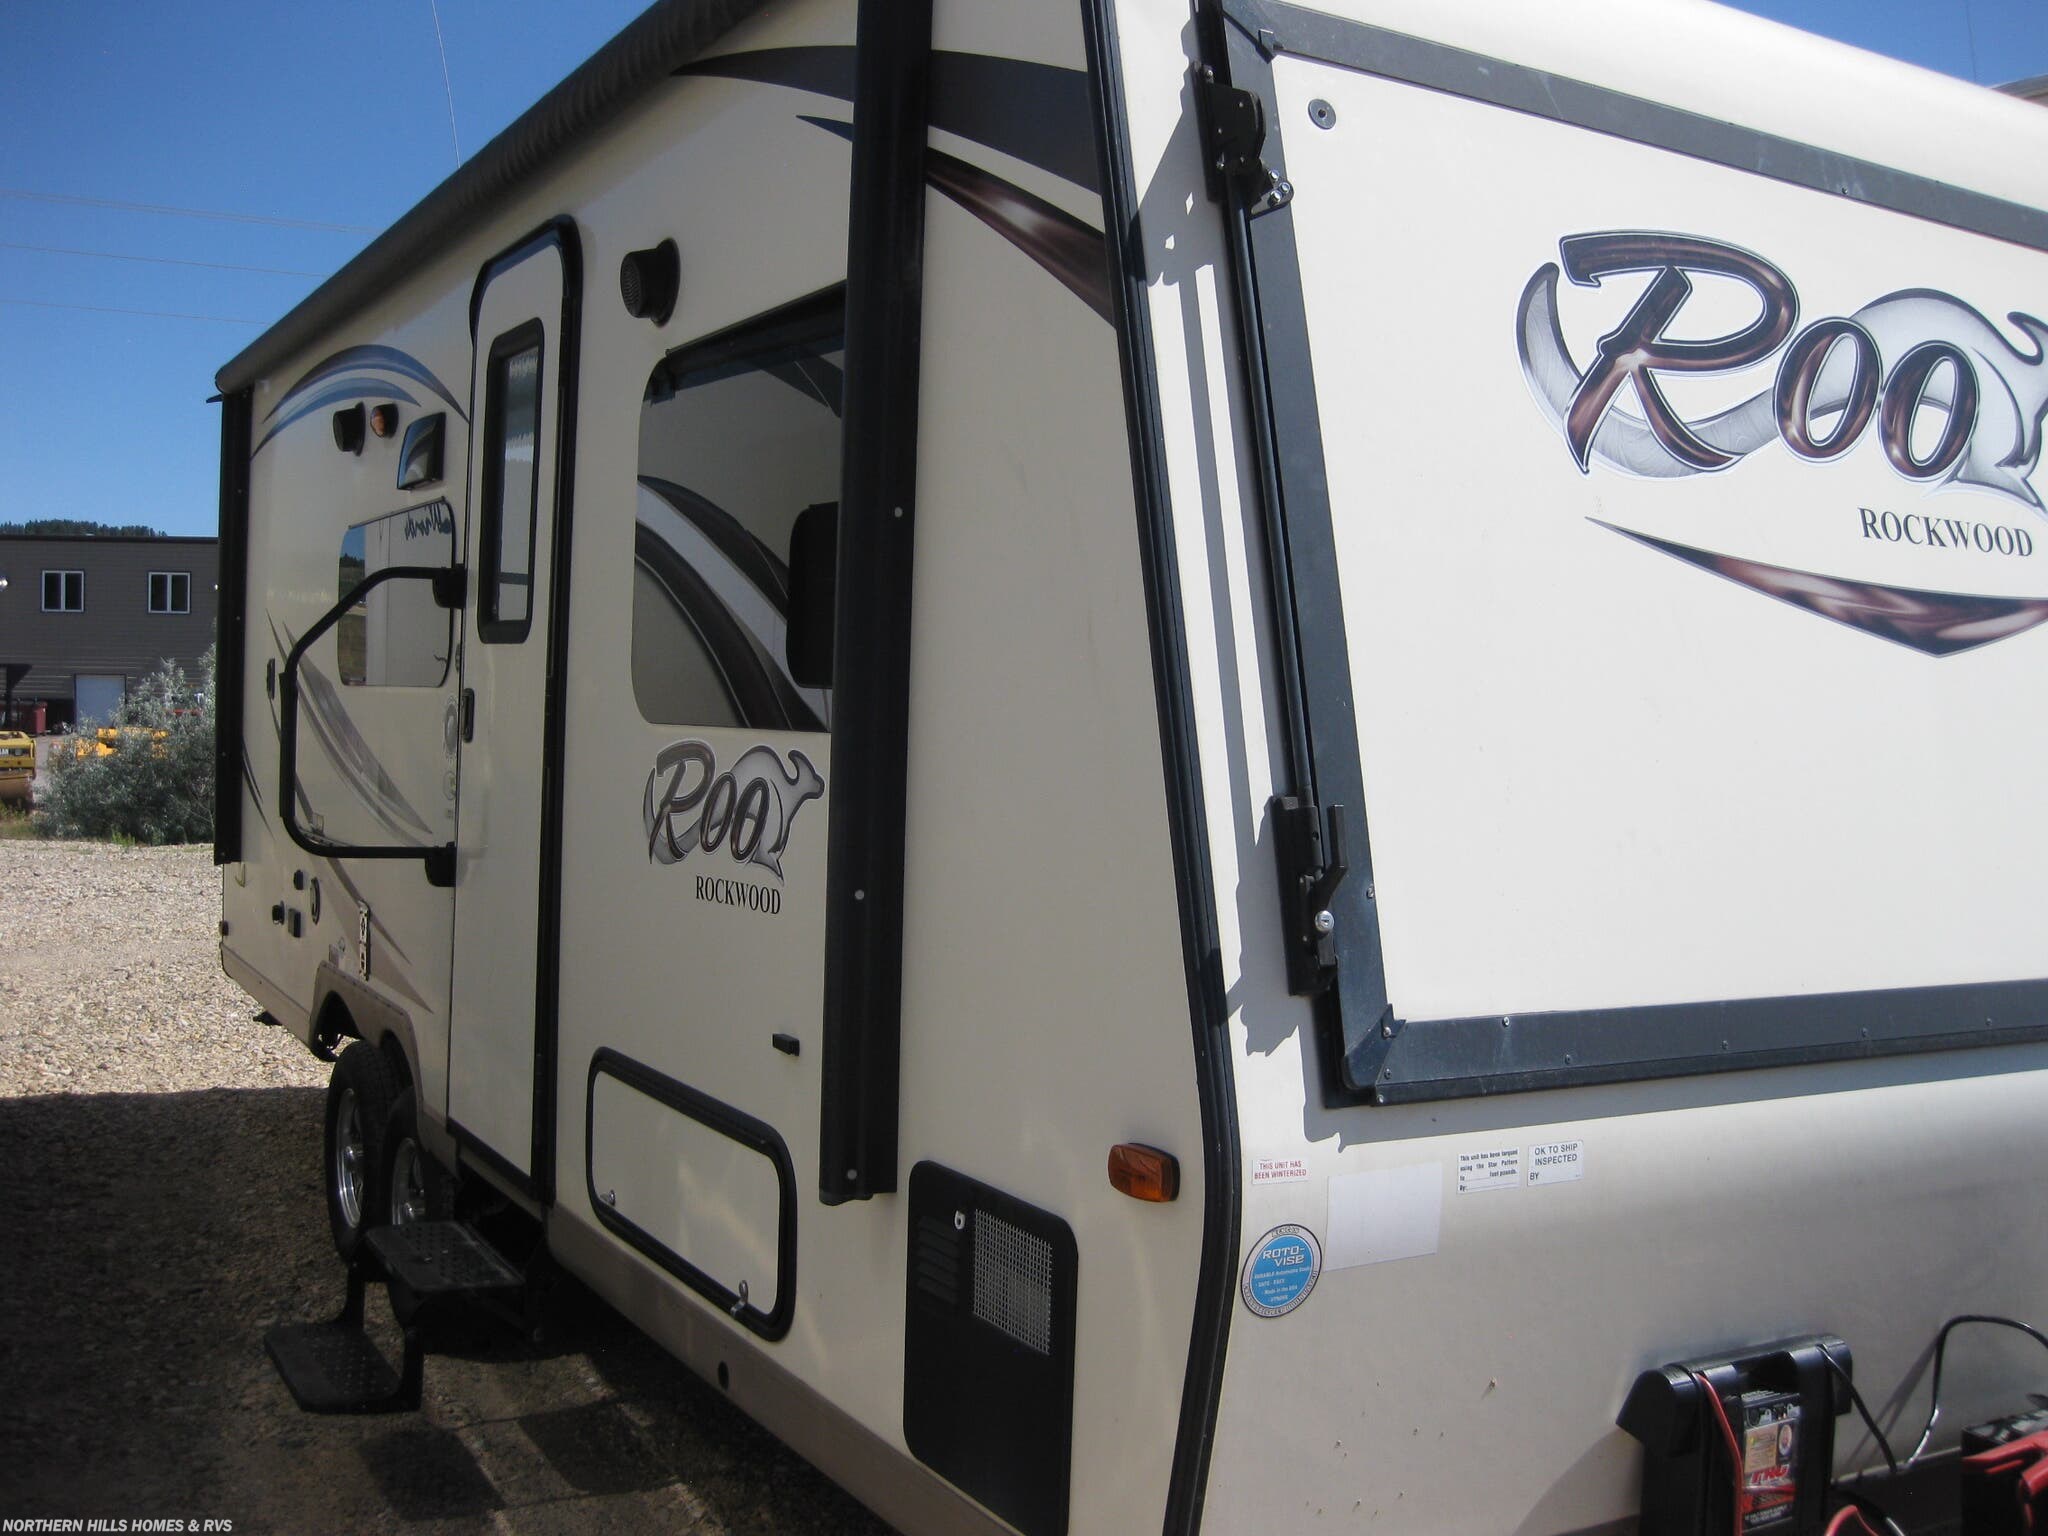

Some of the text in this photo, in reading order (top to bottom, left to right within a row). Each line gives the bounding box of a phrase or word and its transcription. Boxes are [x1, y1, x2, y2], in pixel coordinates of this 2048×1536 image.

[1856, 506, 2034, 558] ROCKWOOD
[695, 873, 782, 915] ROCKWOOD
[1534, 1143, 1578, 1156] OK TO SHIP
[1259, 1160, 1302, 1170] THIS UNIT HAS
[1535, 1153, 1578, 1166] INSPECTED
[1254, 1168, 1307, 1180] BEEN WINTERIZED
[1529, 1172, 1540, 1180] BY
[1262, 1245, 1305, 1259] ROTO-
[1274, 1254, 1305, 1267] VISE
